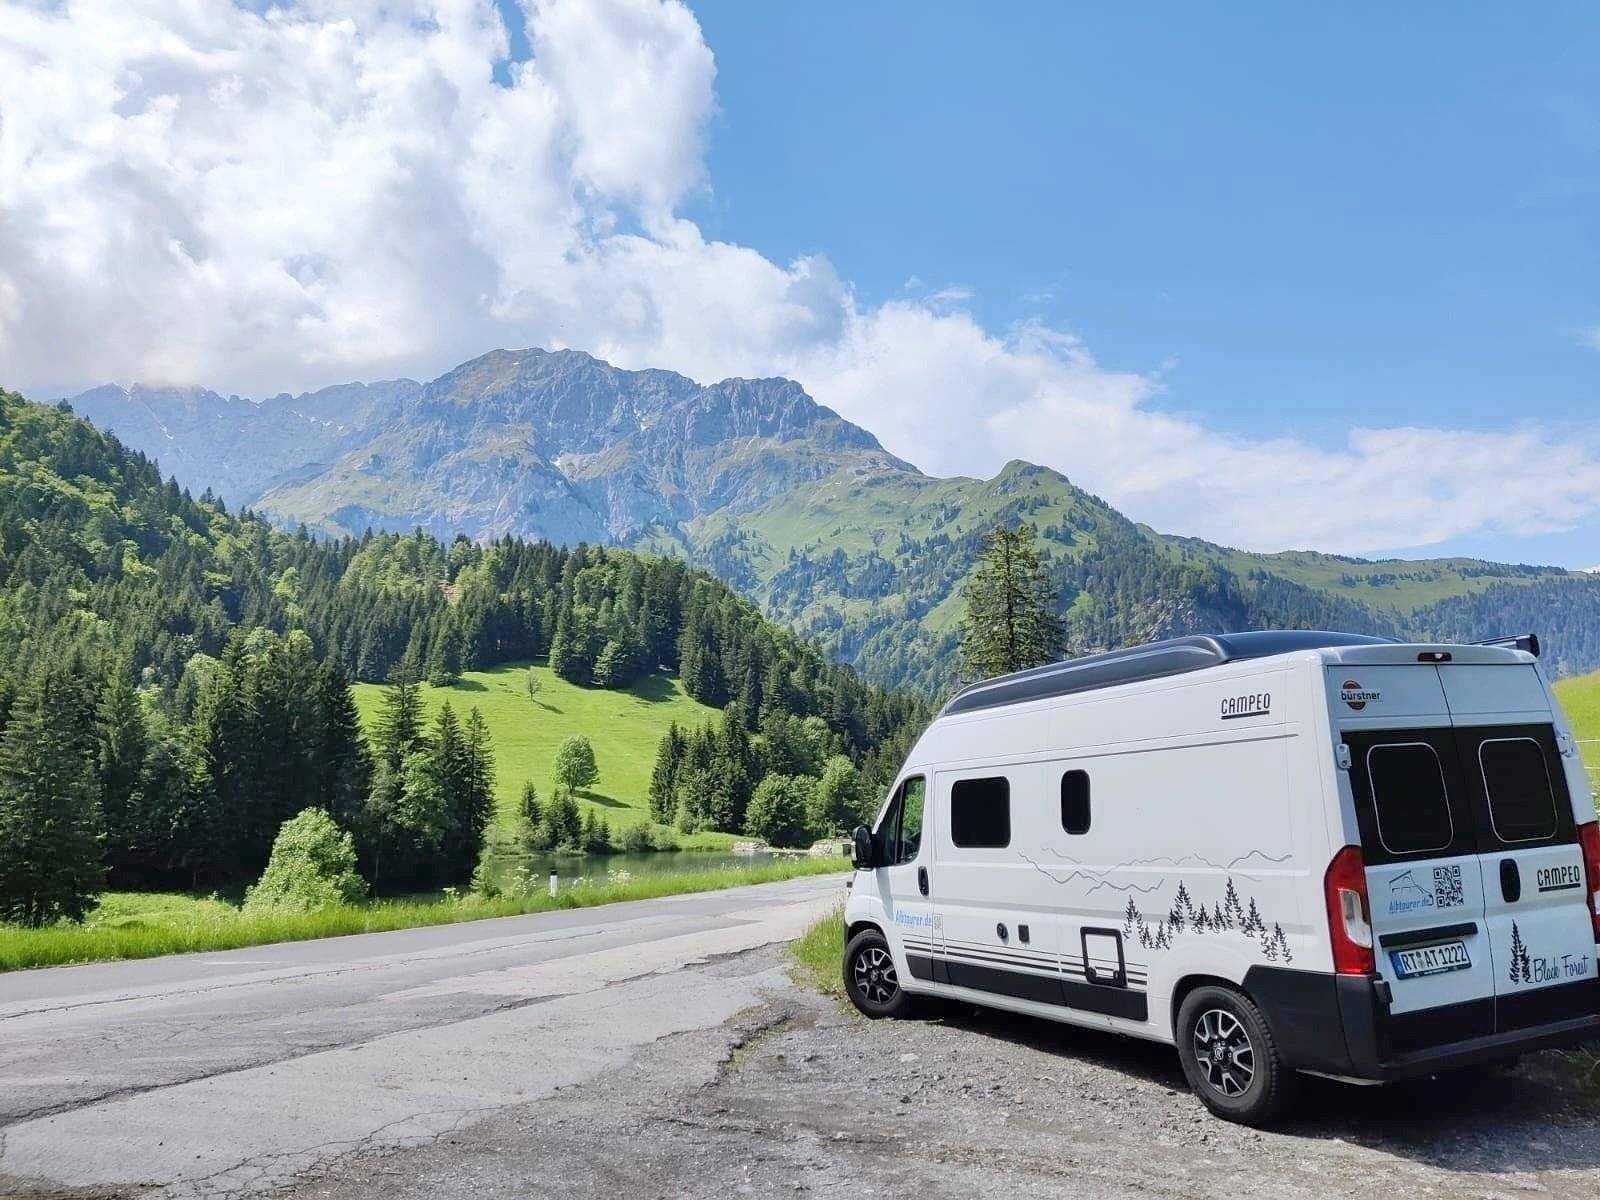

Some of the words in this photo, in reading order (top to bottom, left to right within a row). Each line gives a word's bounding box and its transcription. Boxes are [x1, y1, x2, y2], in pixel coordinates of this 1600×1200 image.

[1221, 693, 1270, 714] CAMPEO
[1341, 690, 1380, 700] bürstner
[1537, 865, 1580, 886] CAMPEO
[1401, 953, 1418, 971] RT
[1533, 957, 1559, 983] Black
[1561, 954, 1589, 977] Forest
